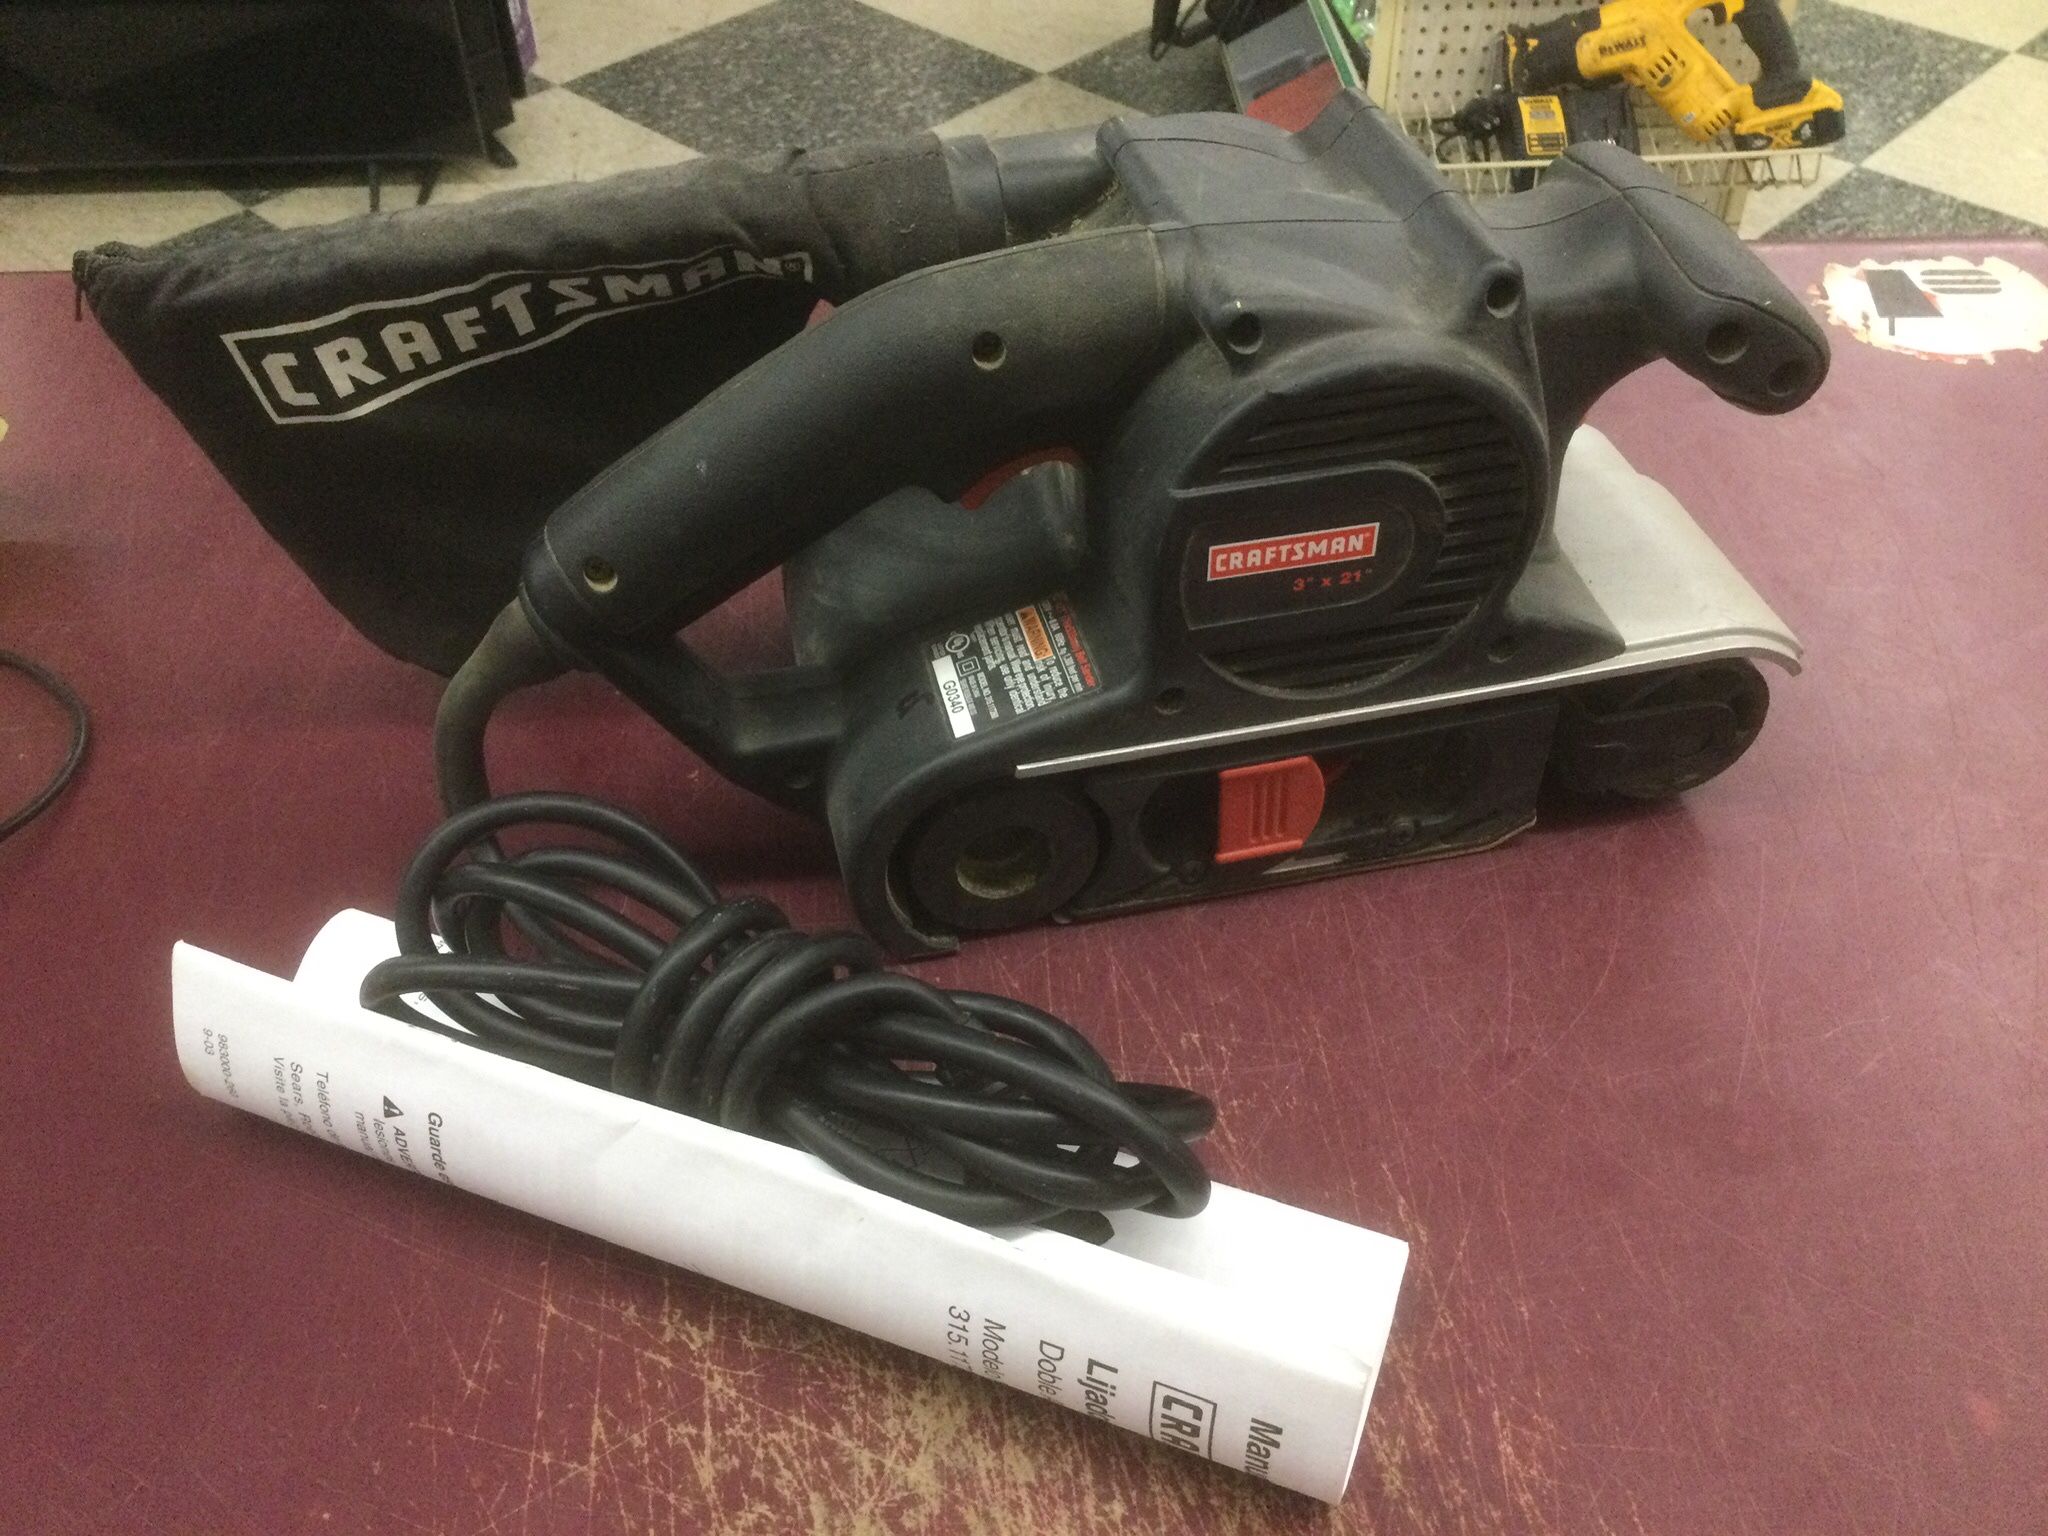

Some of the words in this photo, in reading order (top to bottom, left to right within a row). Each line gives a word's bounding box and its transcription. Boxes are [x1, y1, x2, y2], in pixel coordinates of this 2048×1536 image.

[260, 250, 783, 407] CRAFTSMAN
[1215, 533, 1363, 573] CRAFTSMAN
[942, 679, 965, 715] G0340
[203, 1028, 215, 1056] 9-03
[274, 1057, 286, 1094] Visite
[427, 1112, 447, 1171] Guarde
[1077, 1358, 1119, 1421] Lijad
